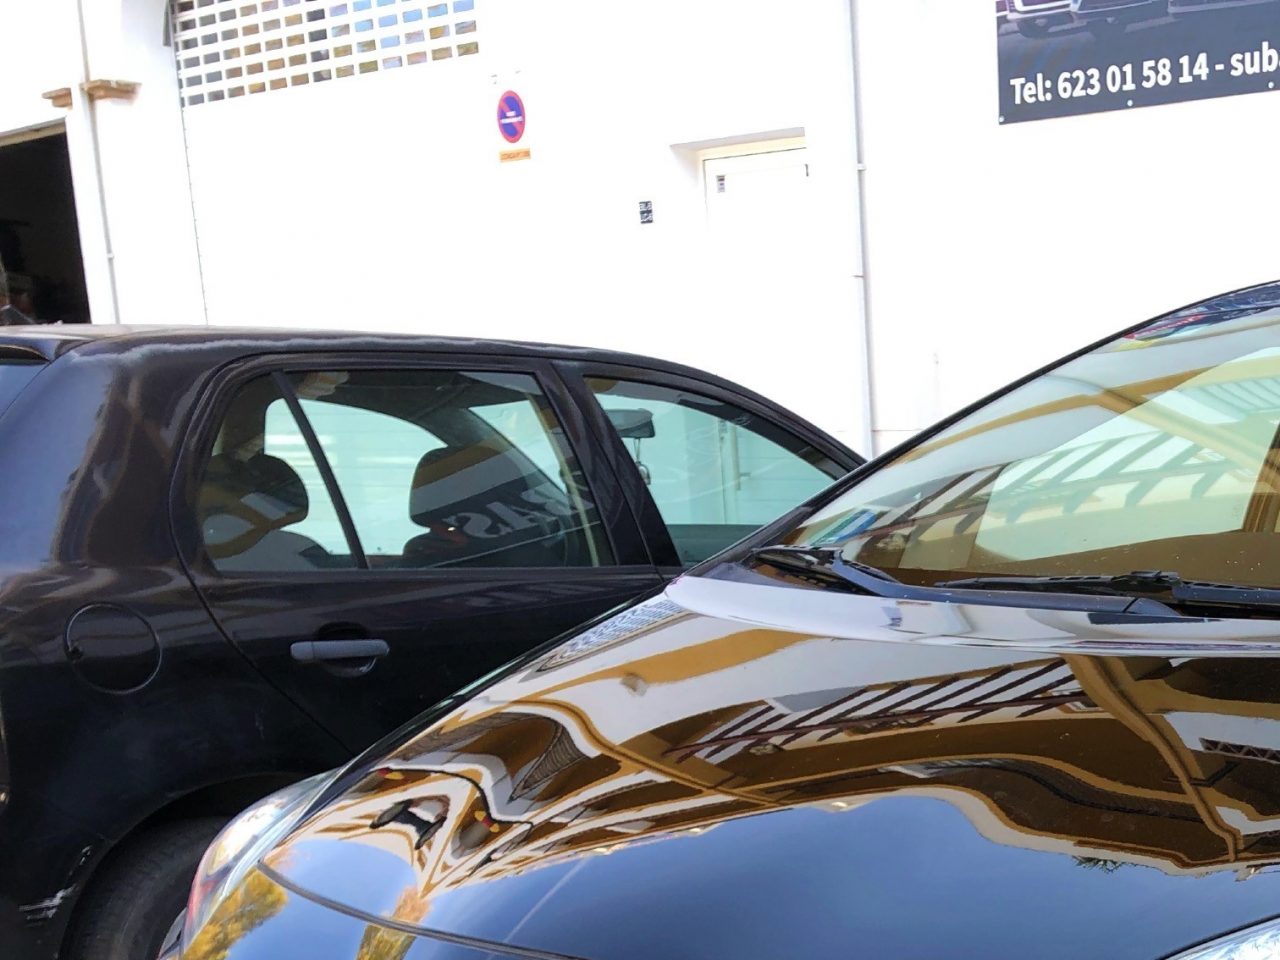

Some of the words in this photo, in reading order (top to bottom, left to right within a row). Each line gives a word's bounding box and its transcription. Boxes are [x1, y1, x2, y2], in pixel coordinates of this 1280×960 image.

[1010, 73, 1051, 104] Tel:
[1057, 68, 1101, 99] 623
[1106, 63, 1136, 93] 01
[1141, 58, 1172, 88] 58
[1178, 52, 1209, 83] 14
